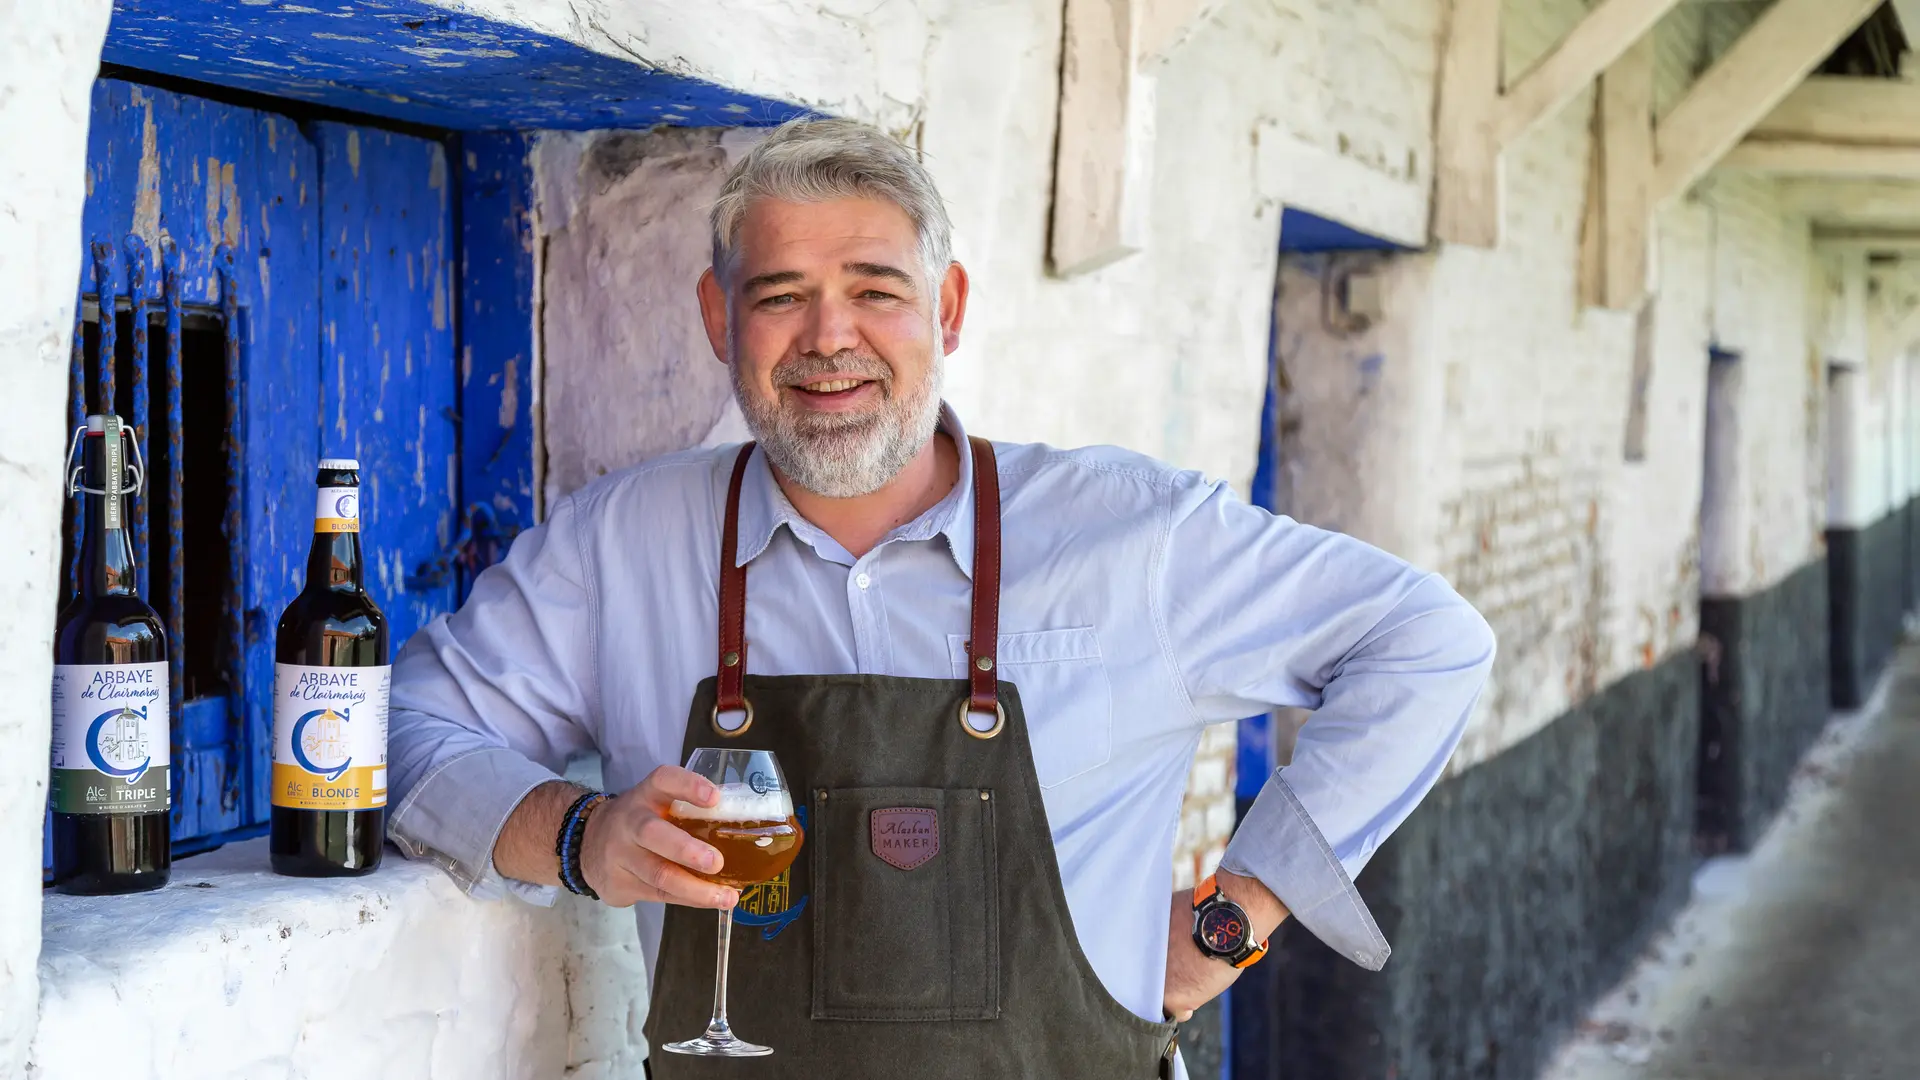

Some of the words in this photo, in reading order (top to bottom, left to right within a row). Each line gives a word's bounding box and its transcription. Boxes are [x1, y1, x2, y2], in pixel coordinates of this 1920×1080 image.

[92, 669, 153, 684] ABBAYE
[299, 672, 358, 687] ABBAYE
[81, 685, 94, 699] de
[97, 682, 160, 704] Clairmarais
[290, 685, 300, 698] de
[303, 684, 366, 706] Clairmarais
[86, 786, 107, 797] Alc.
[287, 781, 304, 793] Alc.
[312, 788, 360, 798] BLONDE
[116, 788, 156, 801] TRIPLE
[880, 820, 930, 835] Alaskan
[883, 838, 929, 849] MAKER
